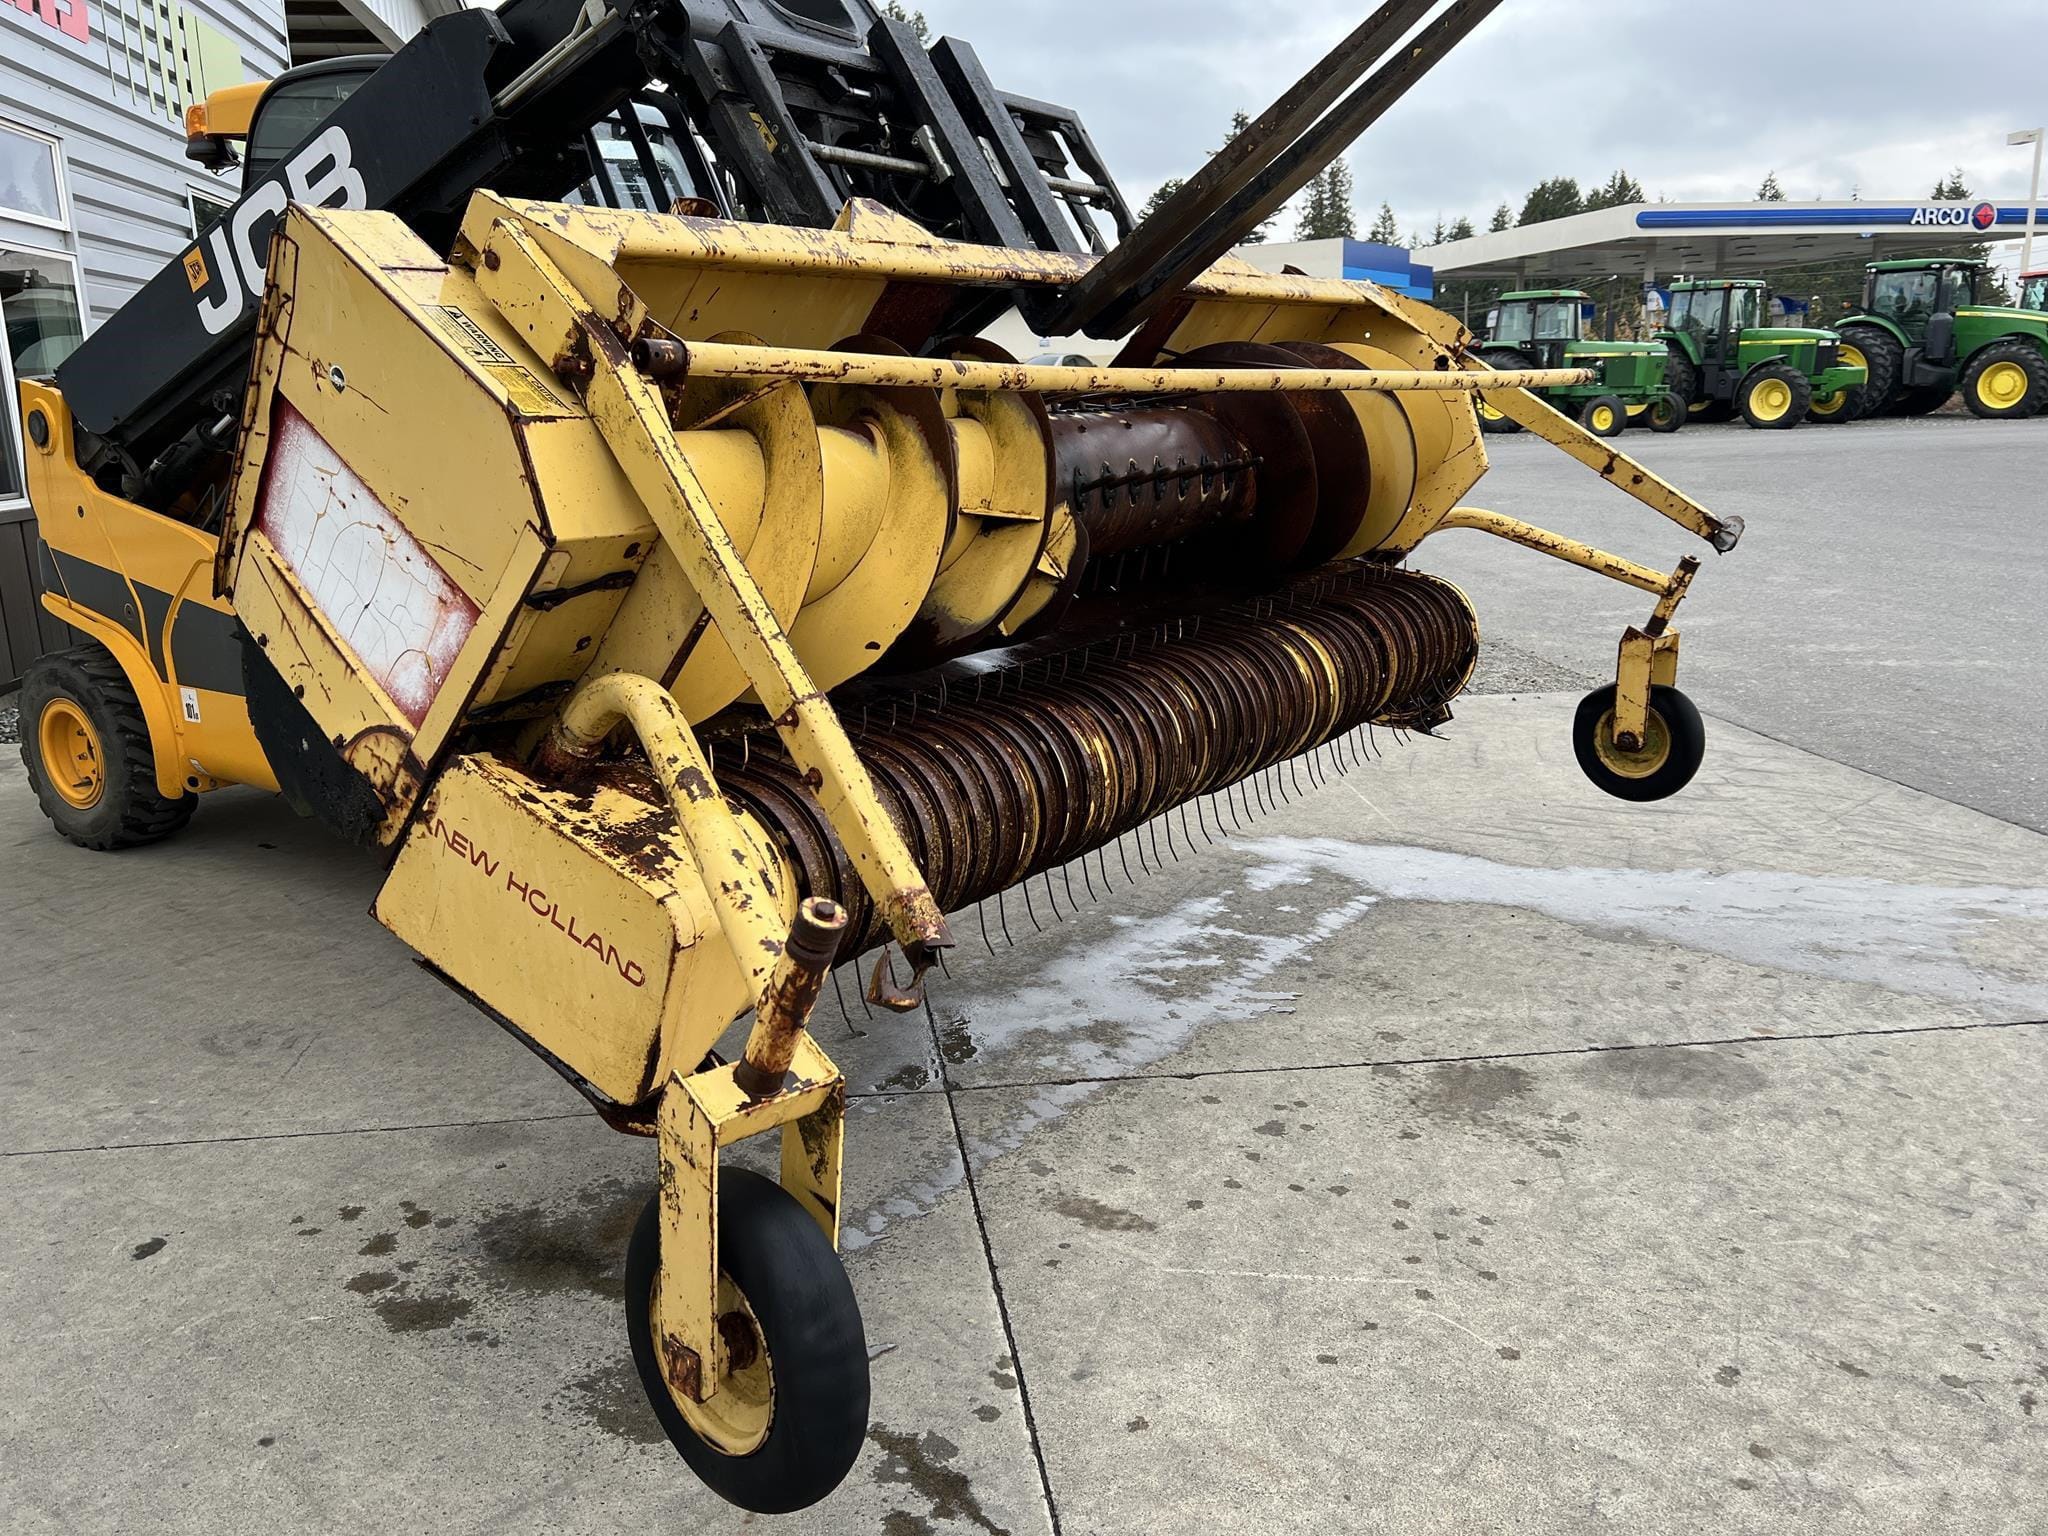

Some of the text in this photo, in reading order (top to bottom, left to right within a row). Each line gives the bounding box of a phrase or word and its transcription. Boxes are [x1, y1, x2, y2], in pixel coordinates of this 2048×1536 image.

[197, 125, 367, 335] JCB
[1910, 207, 1966, 225] ARCO
[188, 260, 203, 281] JCB
[461, 320, 506, 360] WARNING
[530, 380, 564, 408] CAUTION
[430, 818, 646, 988] NEW HOLLAND
